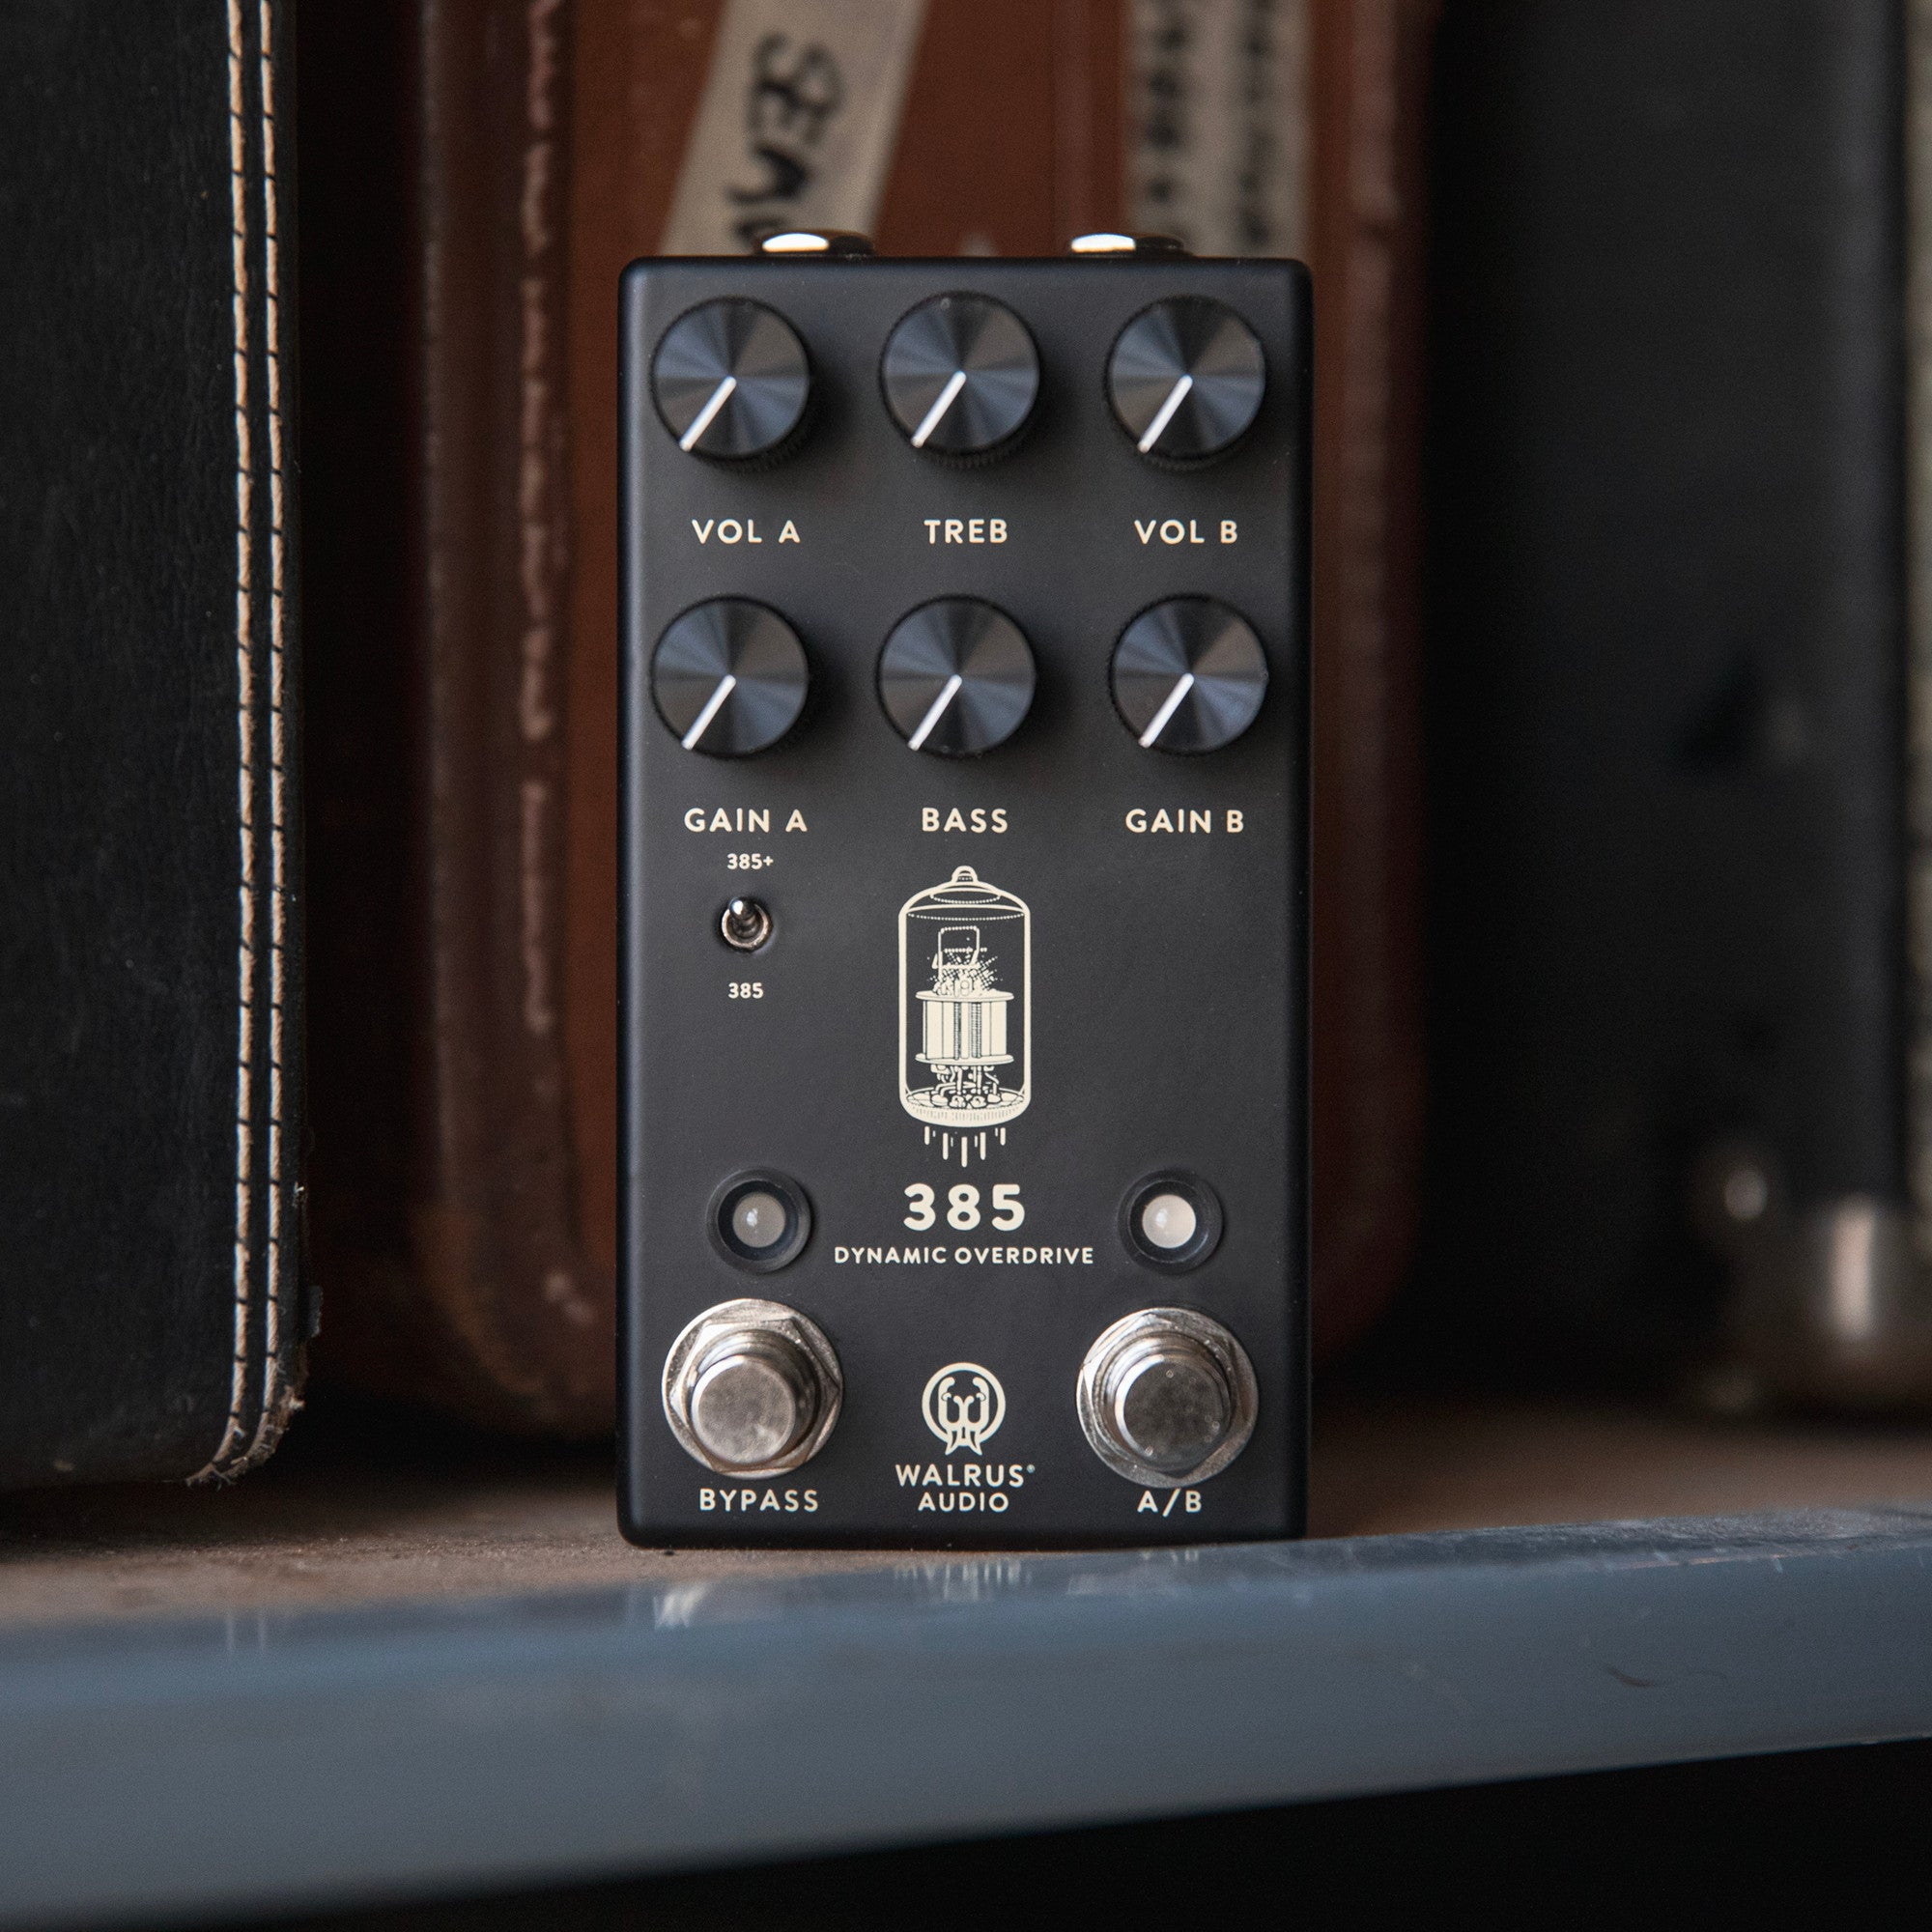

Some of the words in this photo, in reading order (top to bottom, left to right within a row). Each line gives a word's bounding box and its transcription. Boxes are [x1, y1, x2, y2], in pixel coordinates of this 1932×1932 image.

[692, 519, 762, 544] VOL
[779, 520, 800, 543] A
[923, 519, 1008, 544] TREB
[1134, 520, 1205, 544] VOL
[1221, 520, 1237, 544] B
[684, 808, 769, 833] GAIN
[785, 809, 808, 833] A
[923, 808, 1008, 833] BASS
[1125, 809, 1210, 833] GAIN
[1227, 809, 1243, 833] B
[727, 853, 774, 869] 385+
[728, 981, 764, 999] 385
[903, 1183, 1025, 1232] 385
[834, 1247, 947, 1264] DYNAMIC
[954, 1247, 1094, 1264] OVERDRIVE
[699, 1488, 818, 1512] BYPASS
[918, 1492, 1009, 1513] AUDIO
[1137, 1489, 1202, 1517] A/B
